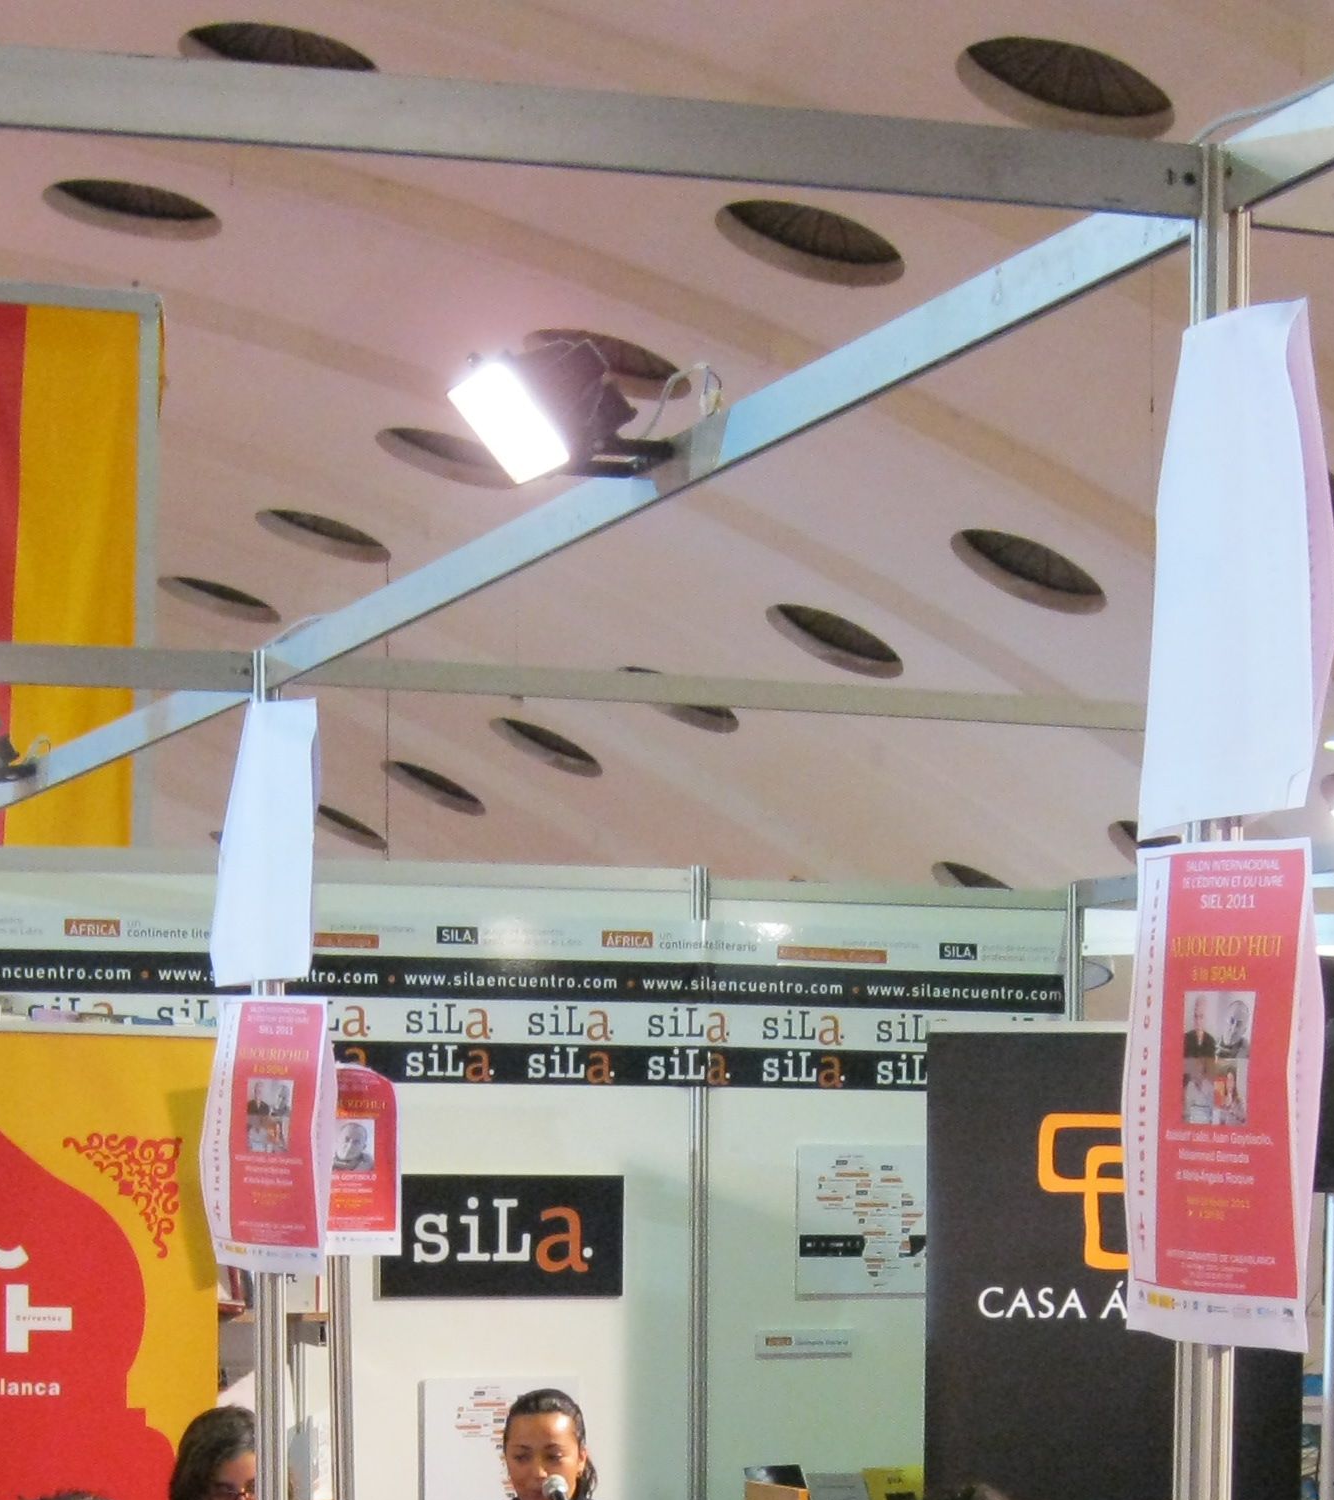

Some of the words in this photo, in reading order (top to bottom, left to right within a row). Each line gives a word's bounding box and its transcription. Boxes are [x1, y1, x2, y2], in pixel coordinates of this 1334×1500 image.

[1200, 894, 1224, 909] SIEL
[1226, 893, 1256, 909] 2011
[69, 920, 117, 937] ÁFRICA
[126, 928, 188, 940] continente
[190, 928, 211, 940] lite
[605, 932, 651, 948] ÁFRICA
[403, 970, 618, 990] www.silaencuentro.com
[642, 974, 844, 996] www.silaencuentro.com
[865, 980, 1063, 1002] www.silaencuentro.com
[876, 1013, 927, 1044] siL
[876, 1054, 927, 1086] siL
[977, 1286, 1087, 1321] CASA
[1100, 1280, 1128, 1320] Á
